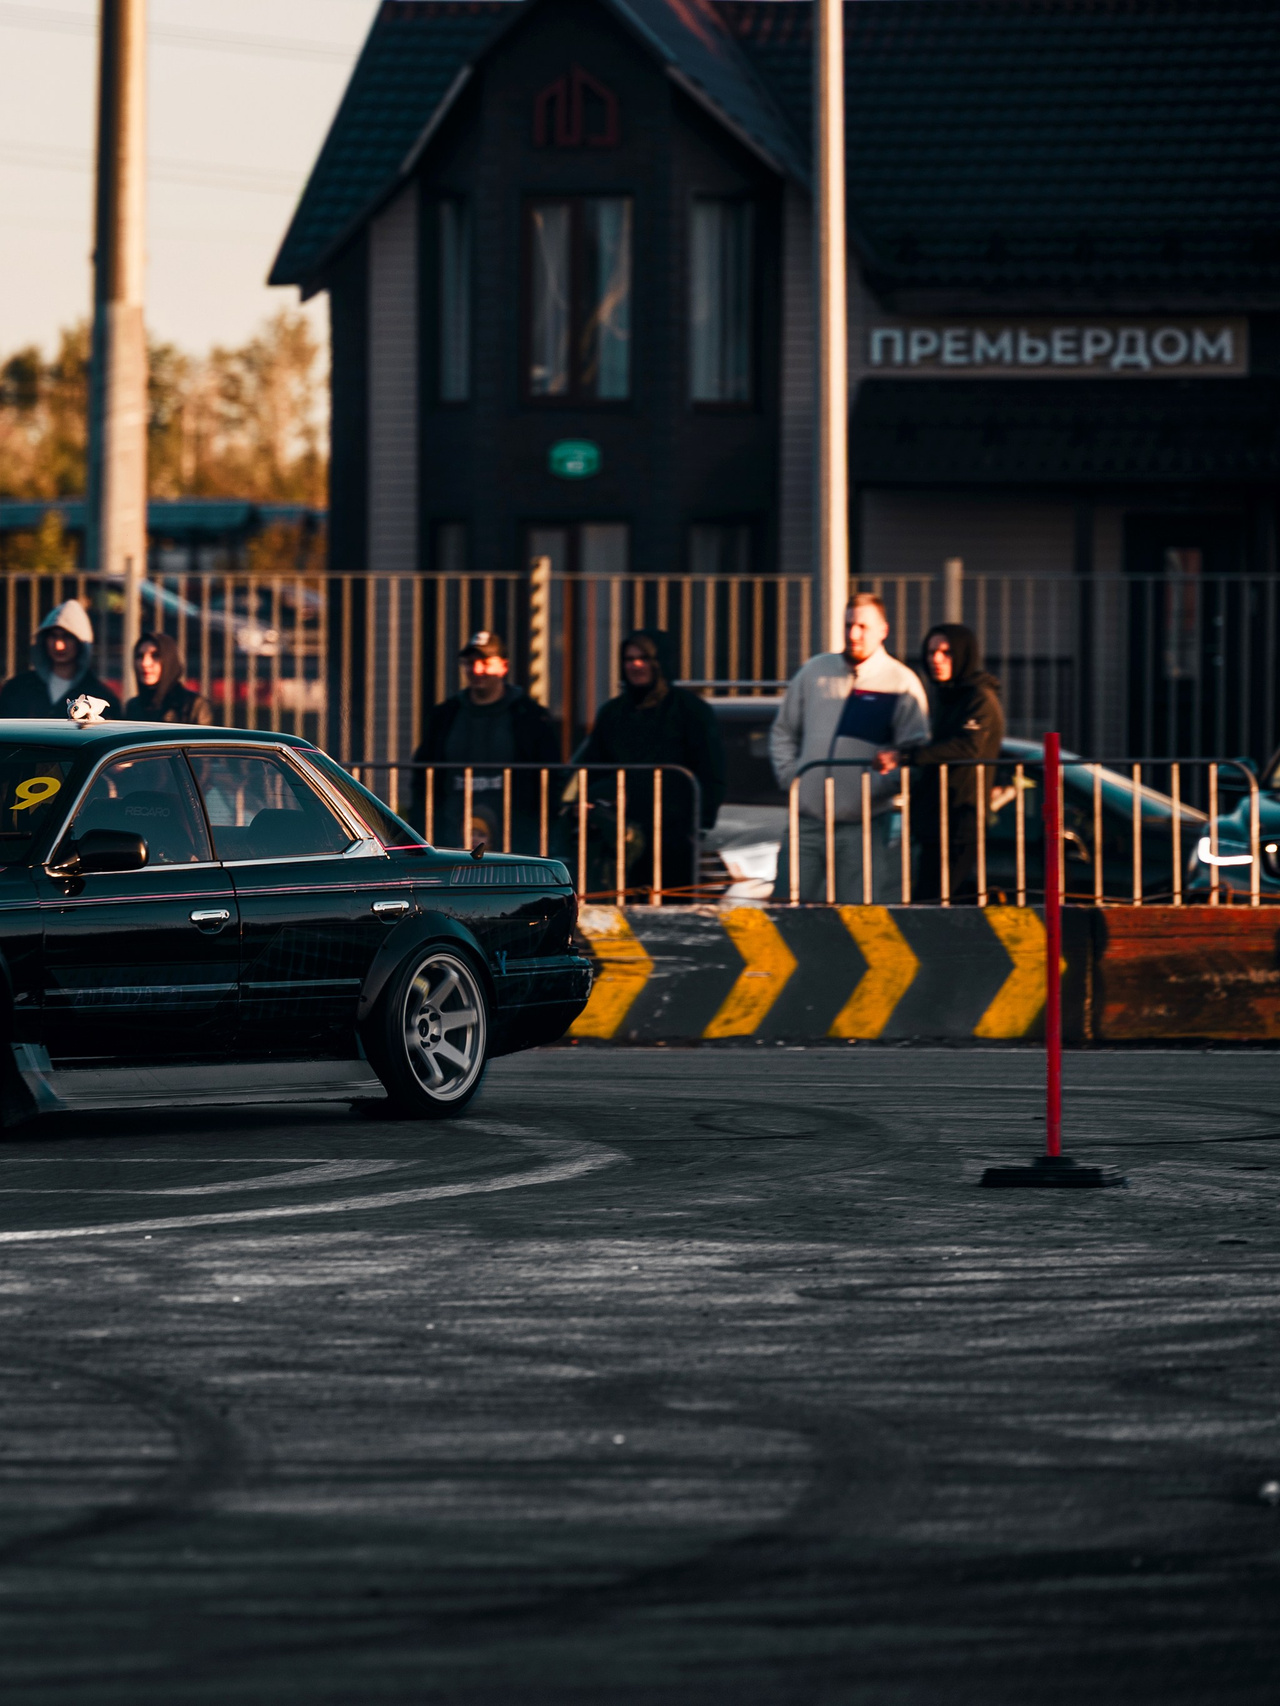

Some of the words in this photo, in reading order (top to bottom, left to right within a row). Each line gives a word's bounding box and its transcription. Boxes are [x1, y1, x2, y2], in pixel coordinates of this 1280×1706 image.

[870, 328, 1233, 370] ПРЕМЬЕРДОМ
[10, 777, 61, 809] 9
[125, 806, 170, 817] RECARO
